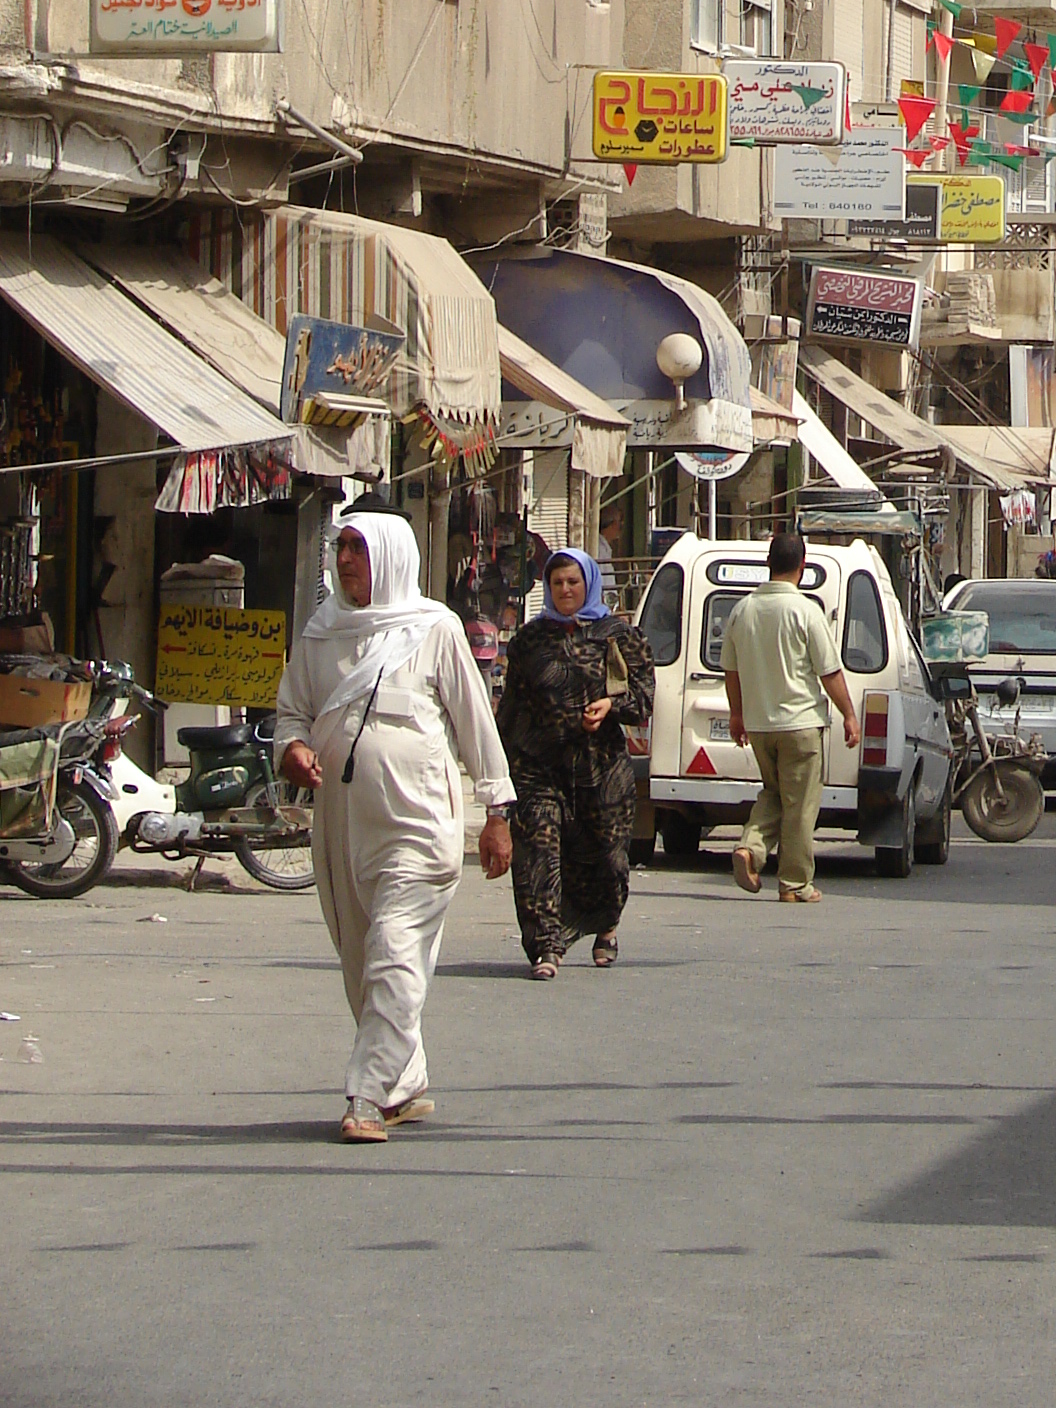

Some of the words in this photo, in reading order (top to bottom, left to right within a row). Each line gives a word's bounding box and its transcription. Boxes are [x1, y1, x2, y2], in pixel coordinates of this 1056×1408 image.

[755, 64, 809, 76] الدكتور
[599, 76, 717, 136] النجاح
[663, 118, 714, 135] ساعات
[659, 139, 715, 158] عطورات
[204, 608, 259, 640] وضيافة
[259, 617, 281, 642] بن
